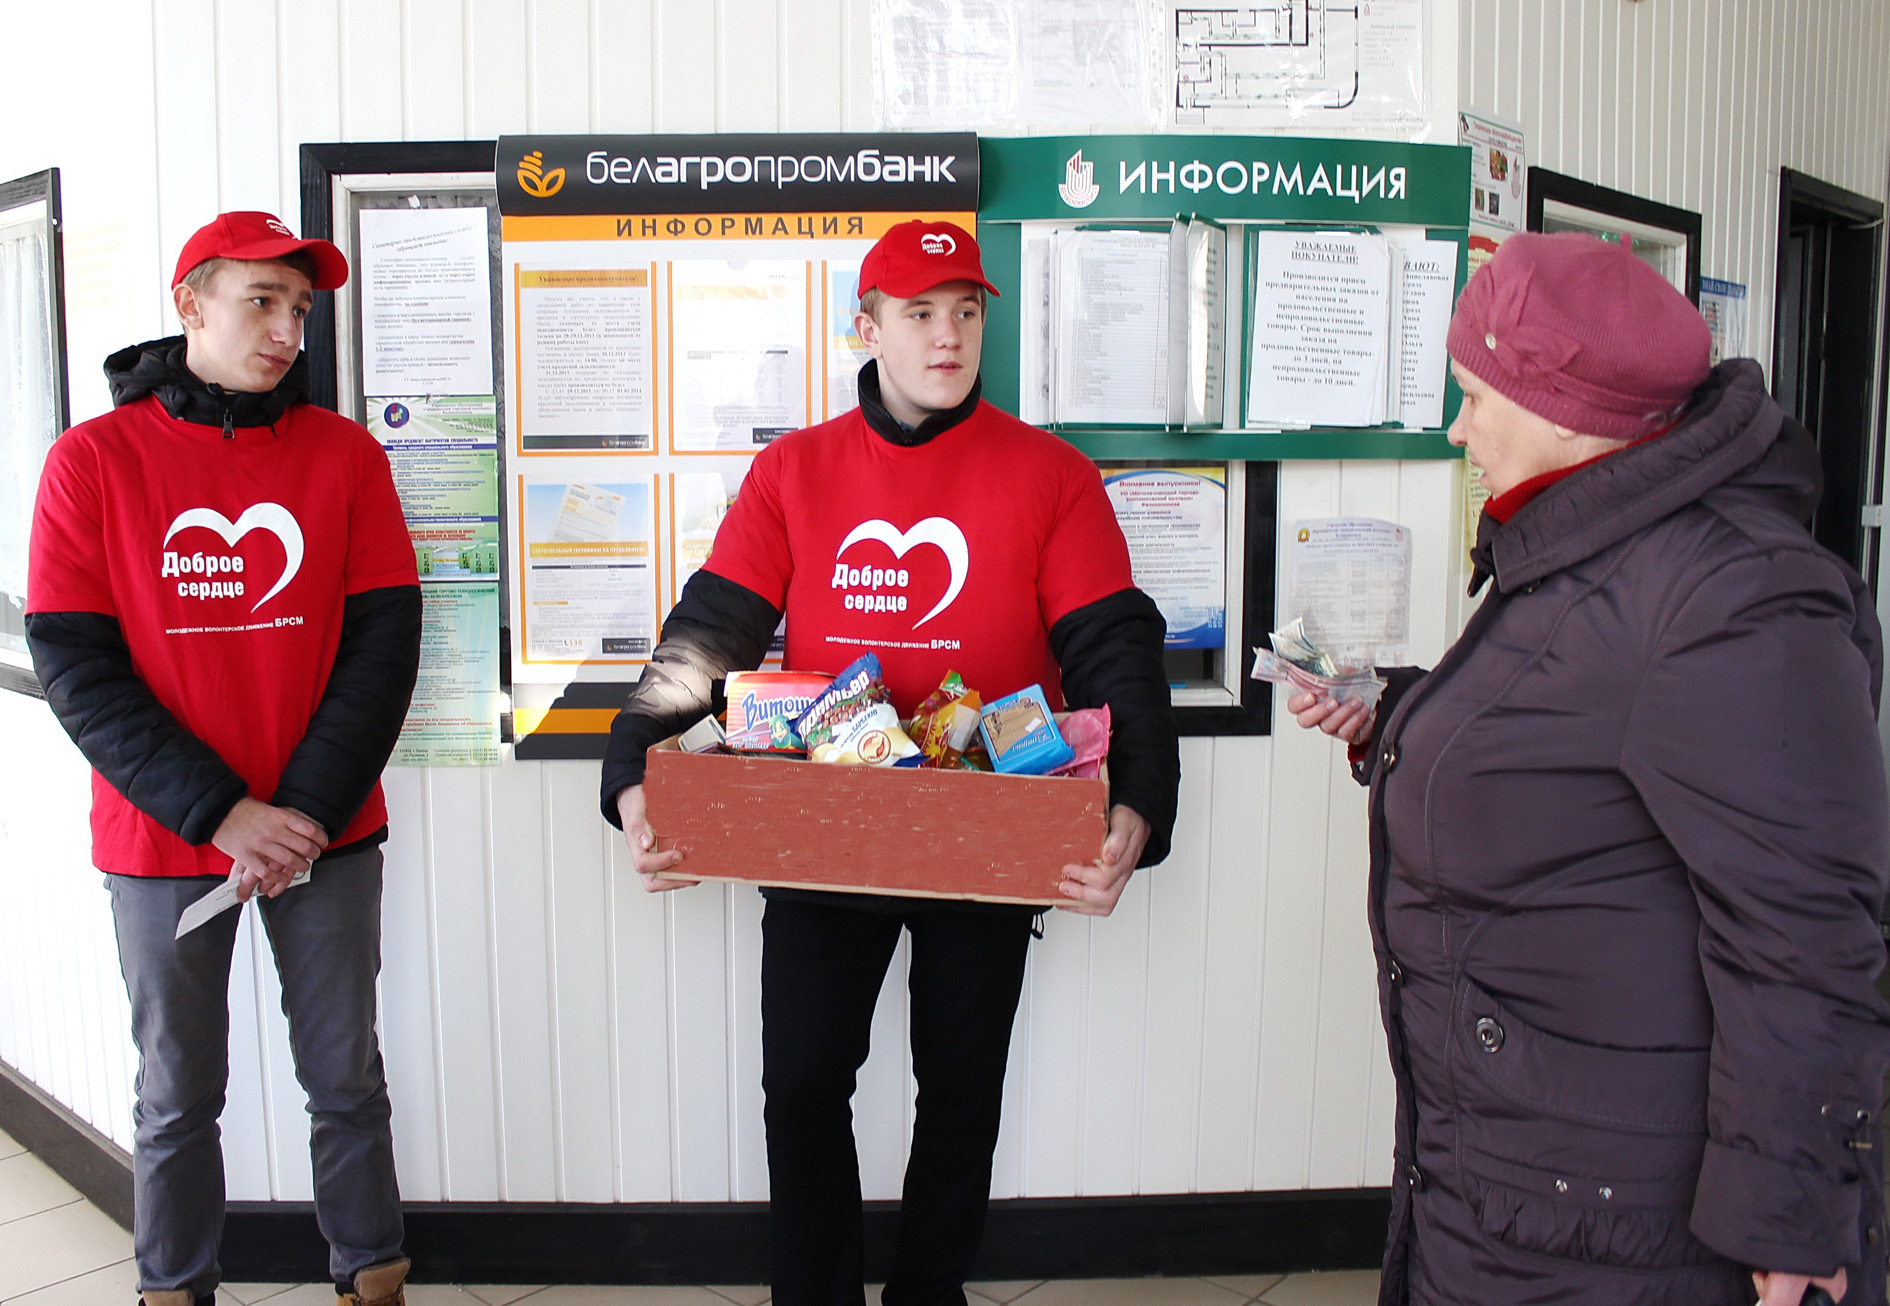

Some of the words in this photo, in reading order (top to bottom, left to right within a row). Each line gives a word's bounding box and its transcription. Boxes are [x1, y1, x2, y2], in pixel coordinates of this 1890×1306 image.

[586, 148, 956, 190] белагропромбанк
[1118, 158, 1407, 204] ИНФОРМАЦИЯ
[616, 216, 864, 239] ИНФОРМАЦИЯ
[162, 552, 244, 578] Доброе
[832, 563, 909, 591] Доброе
[178, 581, 244, 600] сердце
[845, 593, 907, 614] сердце
[275, 616, 304, 627] БРСМ
[826, 636, 860, 645] МОЛОДЕЖНОЕ
[931, 639, 960, 649] БРСМ
